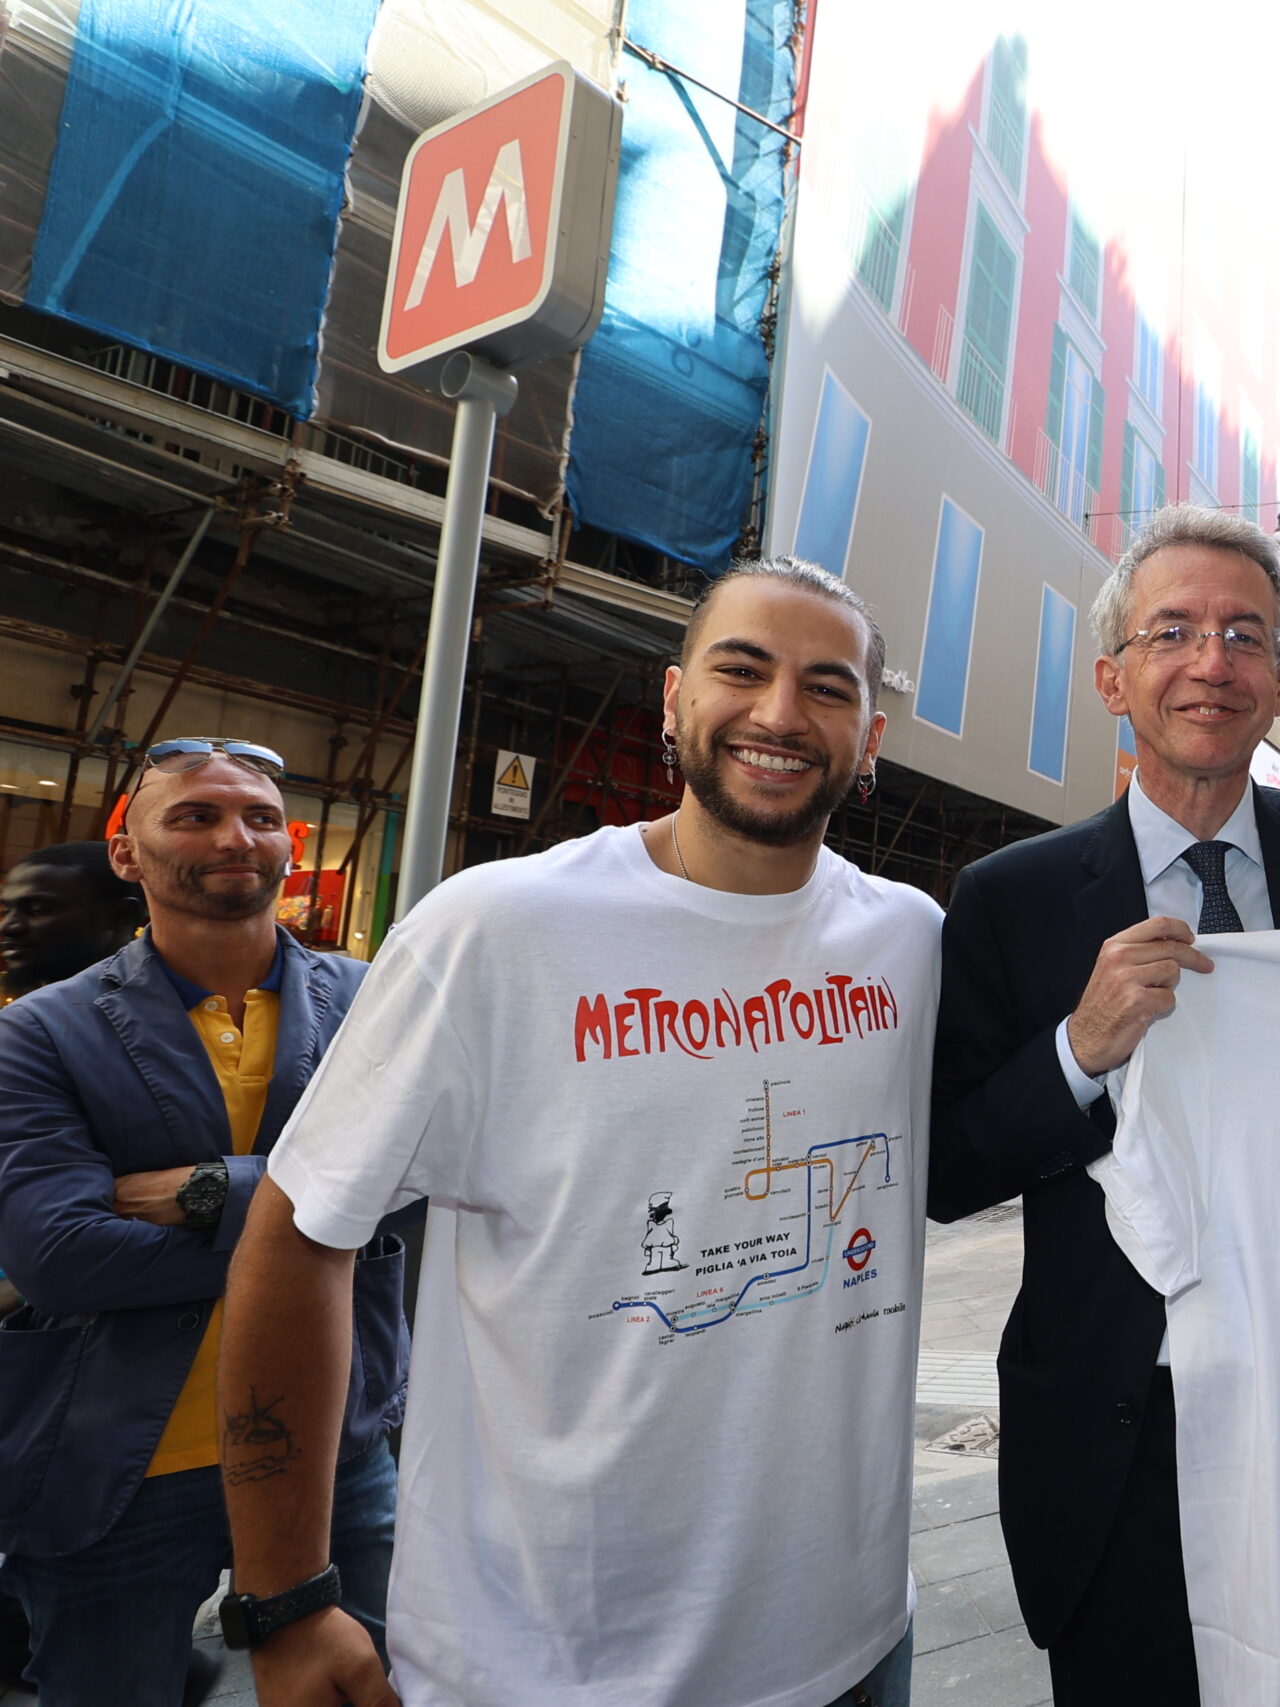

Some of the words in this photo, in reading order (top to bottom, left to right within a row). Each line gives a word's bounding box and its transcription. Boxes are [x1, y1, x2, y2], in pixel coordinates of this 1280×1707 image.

[403, 138, 532, 312] M
[574, 971, 898, 1062] METRONAPOLITAIN
[783, 1109, 801, 1118] LINEA
[700, 1244, 730, 1258] TAKE
[734, 1237, 763, 1251] YOUR
[765, 1232, 790, 1243] WAY
[695, 1261, 734, 1277] PIGLIA
[749, 1253, 767, 1264] VIA
[770, 1247, 797, 1259] TOIA
[843, 1268, 877, 1290] NAPLES
[697, 1288, 719, 1298] LINEA
